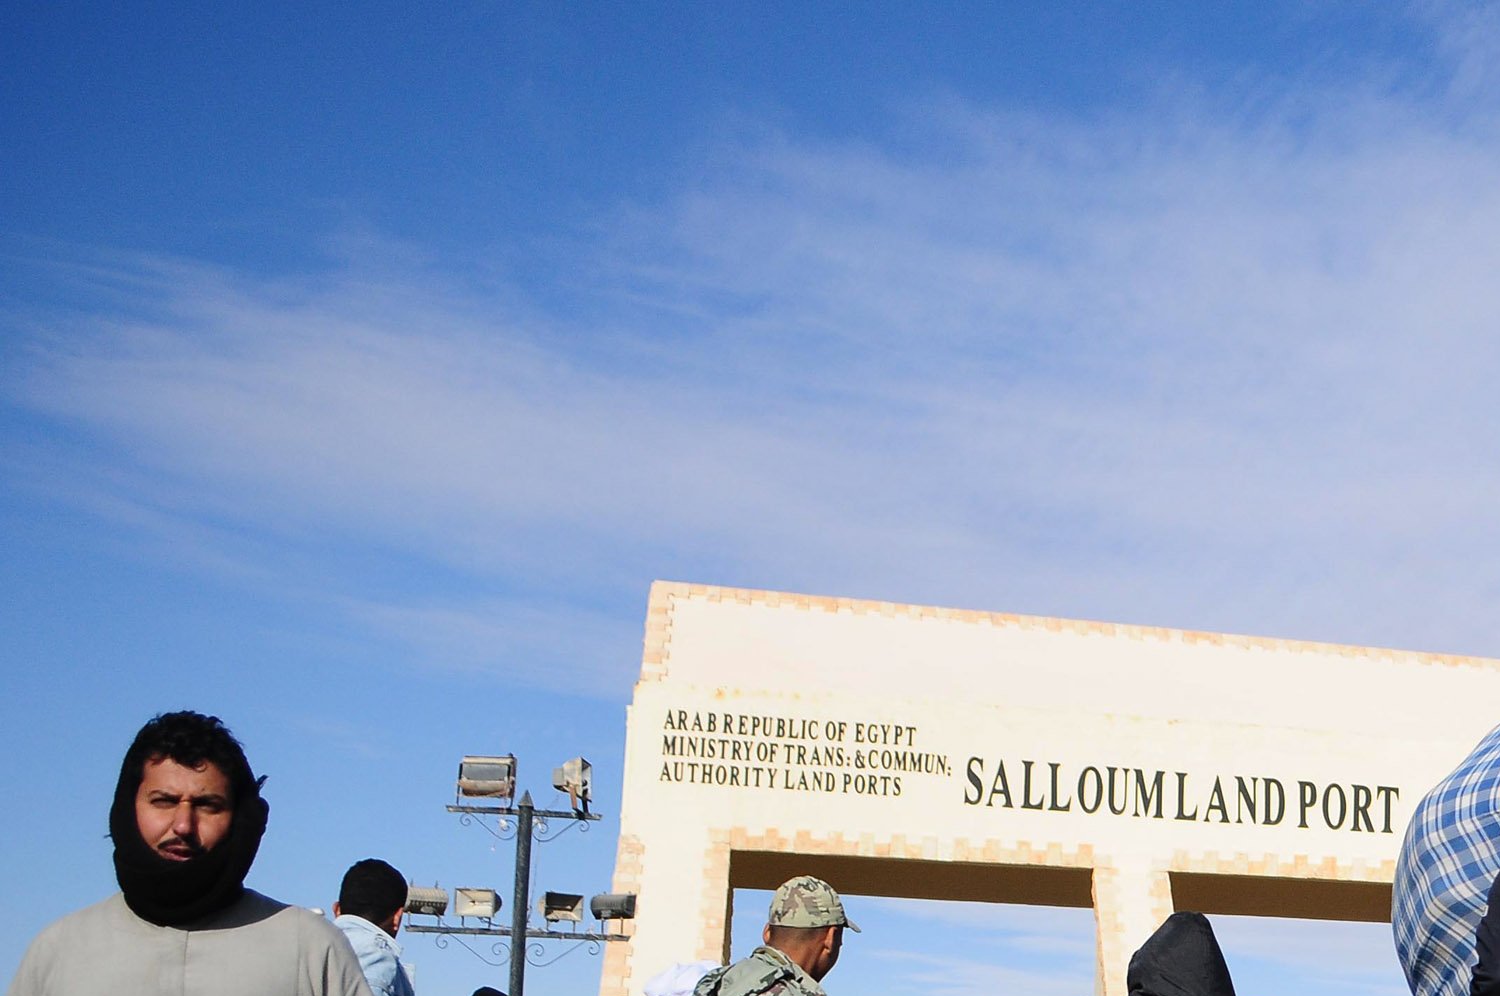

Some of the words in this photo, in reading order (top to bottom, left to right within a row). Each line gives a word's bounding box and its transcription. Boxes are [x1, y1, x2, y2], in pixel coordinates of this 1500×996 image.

[664, 709, 717, 733] ARAB
[722, 713, 819, 740] REPUBLIC
[825, 720, 847, 742] OF
[855, 722, 917, 747] EGYPT
[662, 734, 756, 762] MINISTRY
[756, 741, 779, 763] OF
[660, 761, 778, 788] AUTHORITY
[784, 769, 836, 793] LAND
[842, 773, 902, 797] PORTS
[963, 756, 1166, 819] SALLOUM
[1174, 771, 1286, 826] LAND
[1297, 780, 1400, 834] PORT
